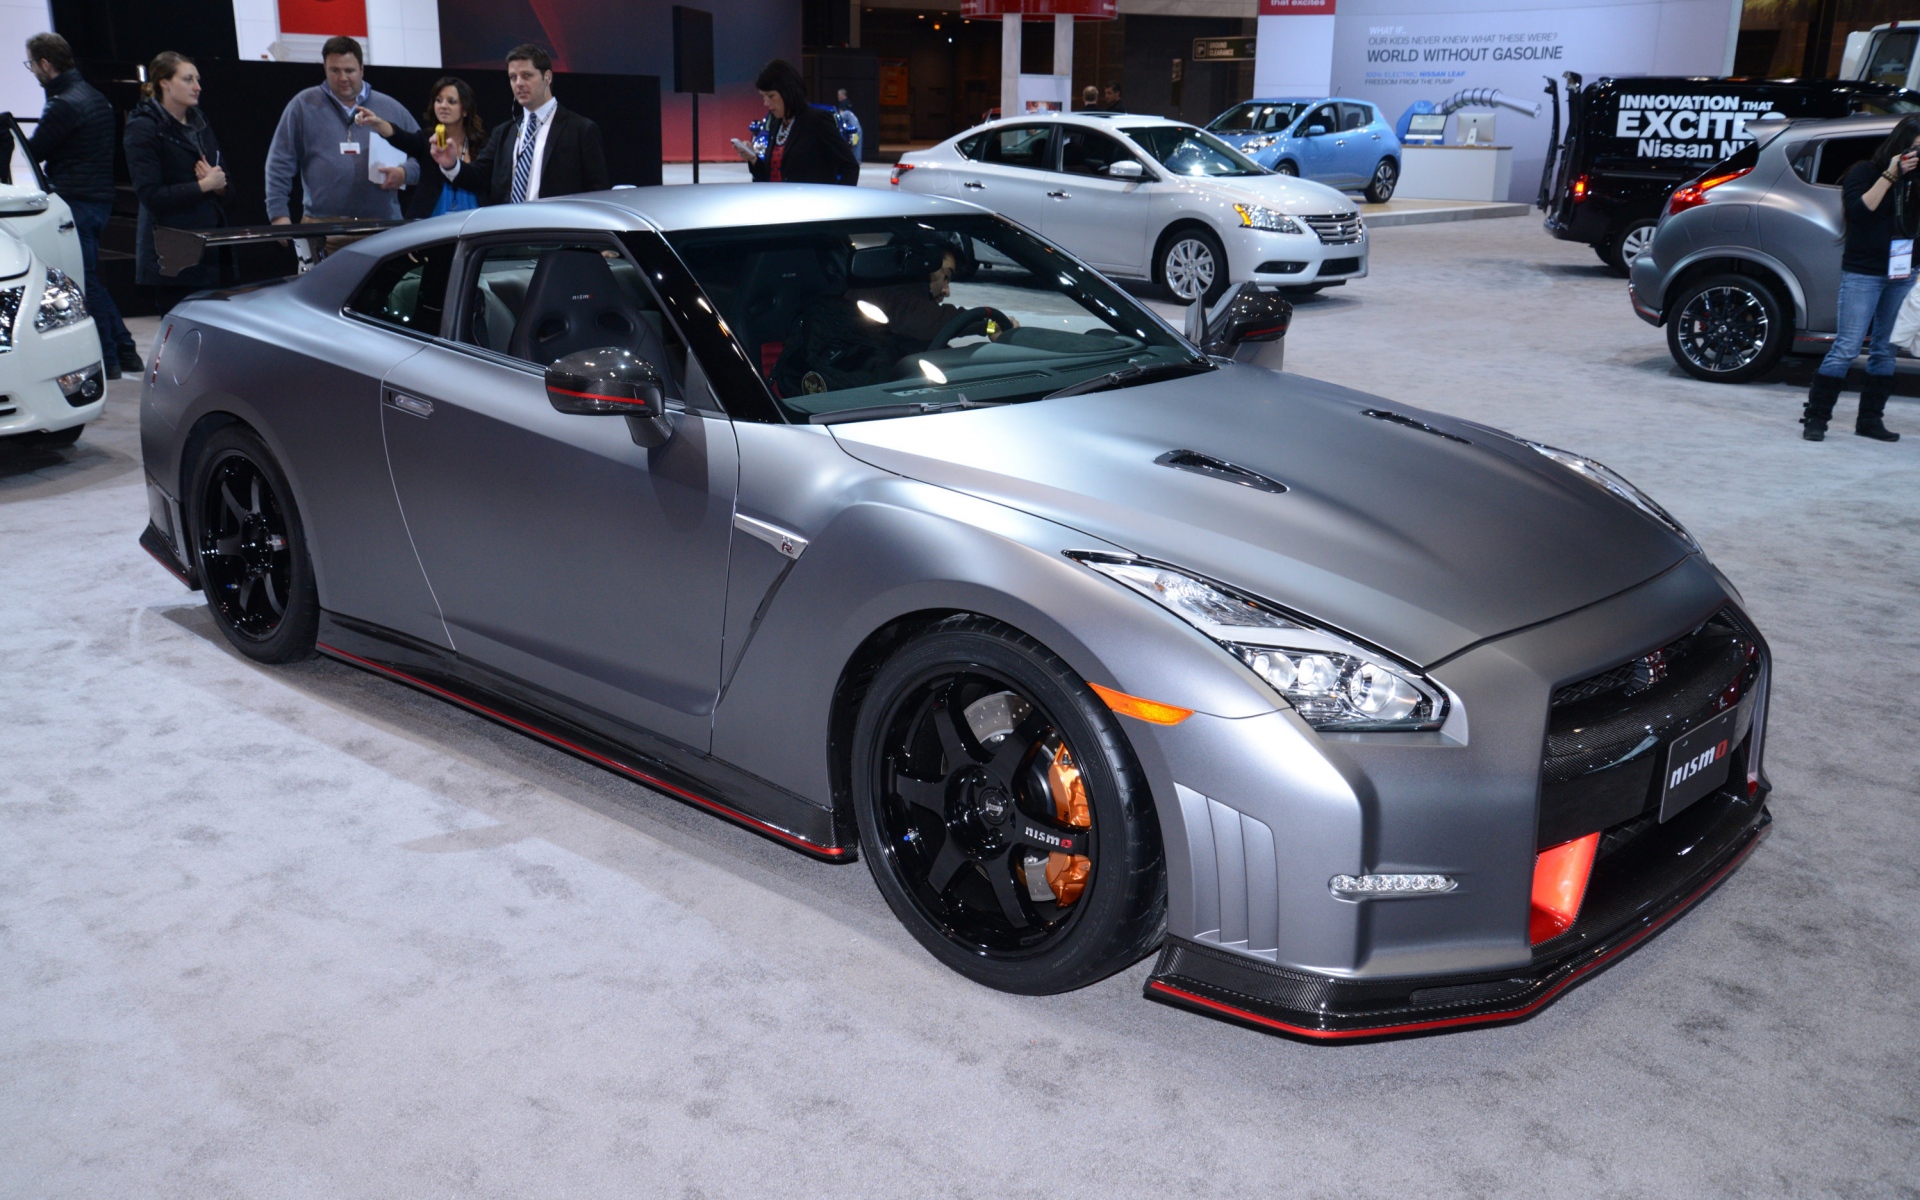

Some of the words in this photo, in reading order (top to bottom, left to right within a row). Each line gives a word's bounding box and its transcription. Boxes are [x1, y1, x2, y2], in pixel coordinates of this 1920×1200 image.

[1368, 37, 1388, 46] OUR
[1389, 36, 1409, 45] KIDS
[1411, 35, 1440, 44] NEVER
[1442, 35, 1469, 44] KNEW
[1471, 34, 1496, 43] WHAT
[1499, 33, 1525, 43] THESE
[1527, 32, 1558, 42] WERE?
[1369, 26, 1394, 35] WHAT
[1367, 49, 1419, 63] WORLD
[1423, 48, 1489, 62] WITHOUT
[1492, 46, 1563, 61] GASOLINE
[1365, 78, 1398, 86] FREEDOM
[1619, 94, 1739, 111] INNOVATION
[1742, 101, 1774, 111] THAT
[1616, 110, 1786, 140] EXCITE
[1637, 139, 1713, 159] Nissan
